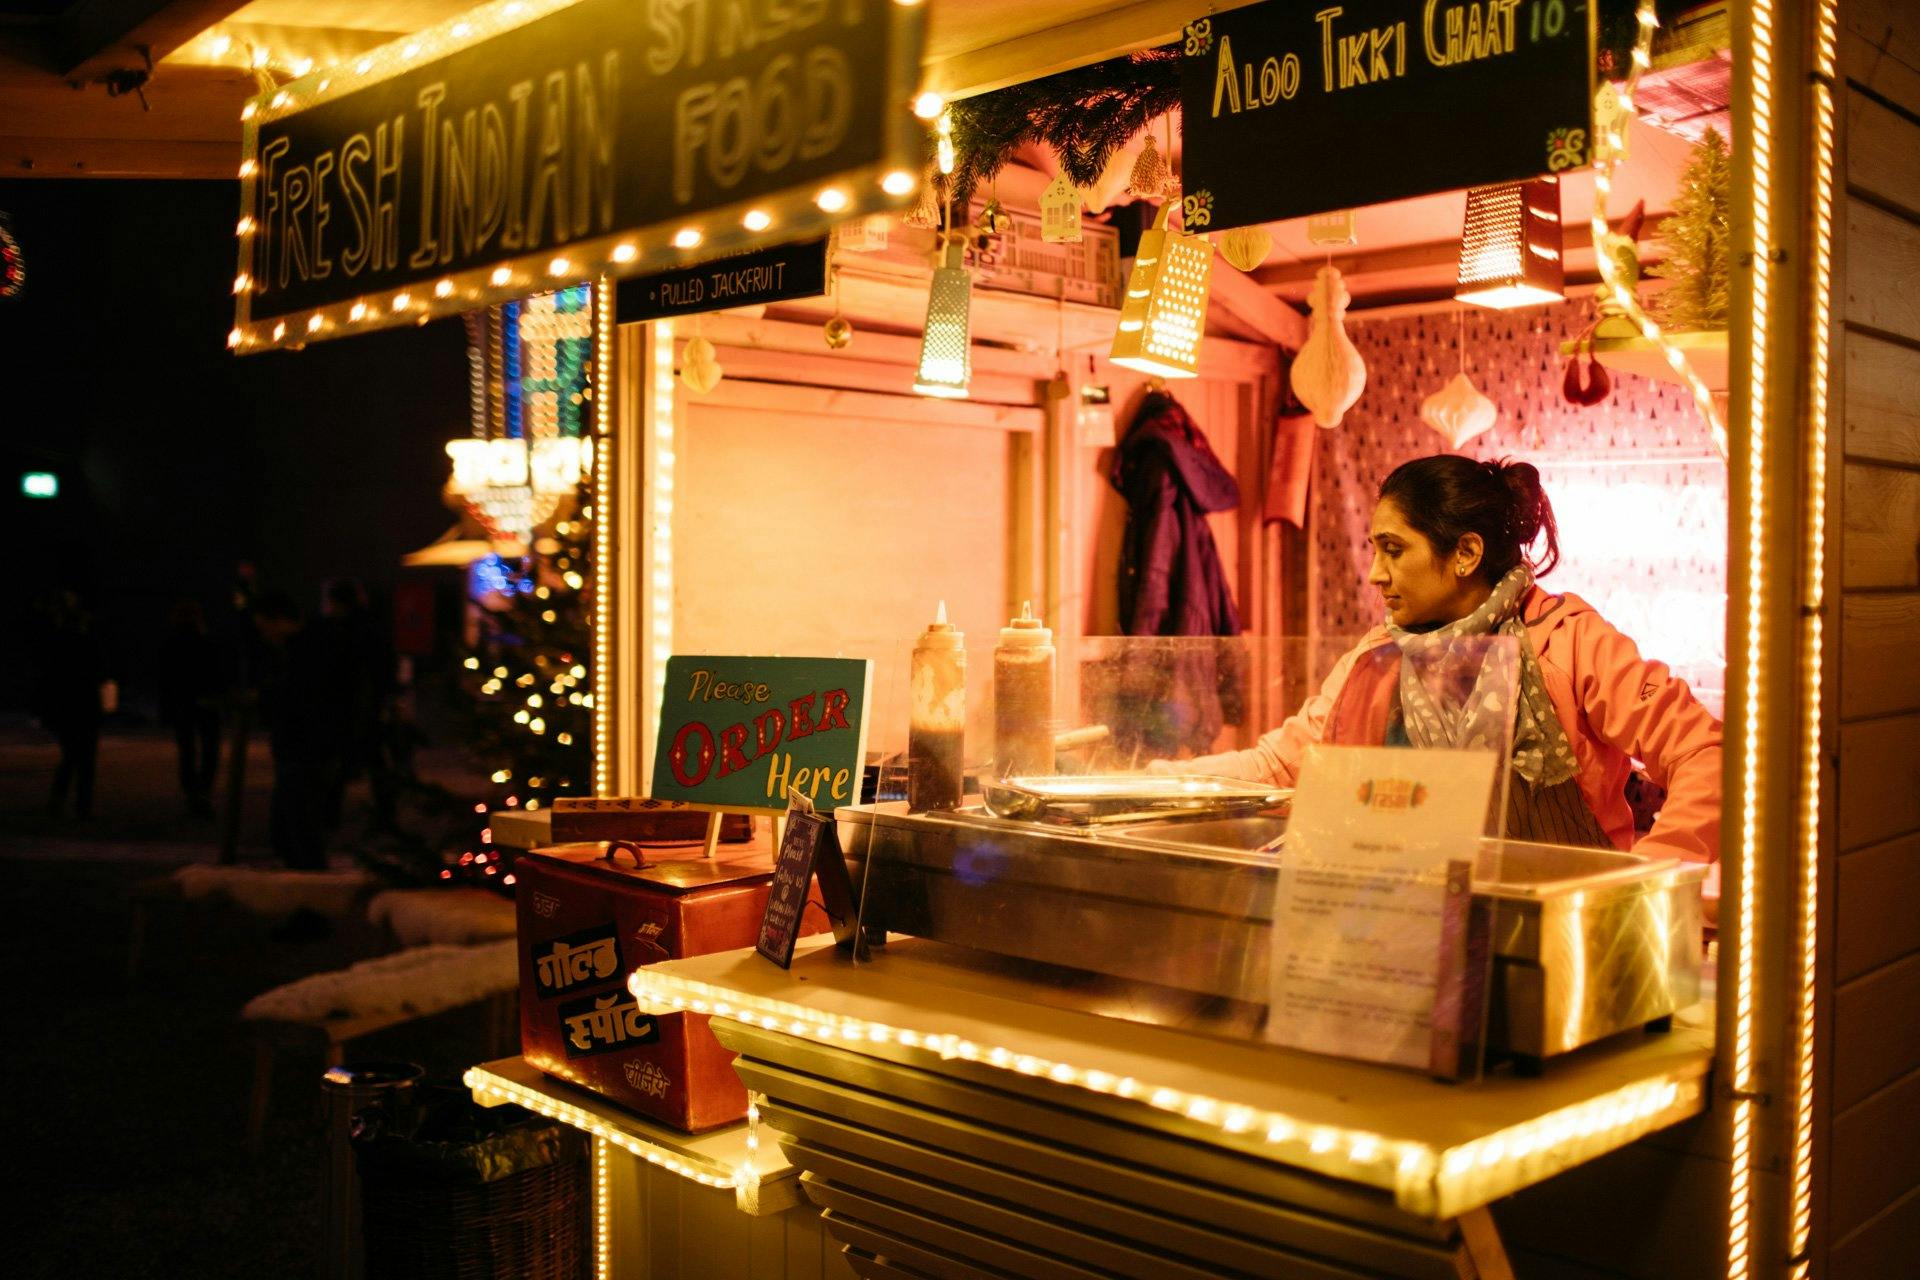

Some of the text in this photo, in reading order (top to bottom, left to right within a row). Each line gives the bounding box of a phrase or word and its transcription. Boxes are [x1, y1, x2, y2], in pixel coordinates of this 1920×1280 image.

[1211, 35, 1301, 118] ALOO
[1315, 6, 1406, 92] TIKKI
[1423, 0, 1521, 67] CHAAT
[258, 49, 619, 296] FRESH INDIAN
[673, 45, 852, 203] FOOD
[660, 262, 787, 307] PULLED JACKFRUIT
[688, 669, 772, 705] Please
[667, 688, 851, 789] ORDER
[766, 753, 850, 800] Here
